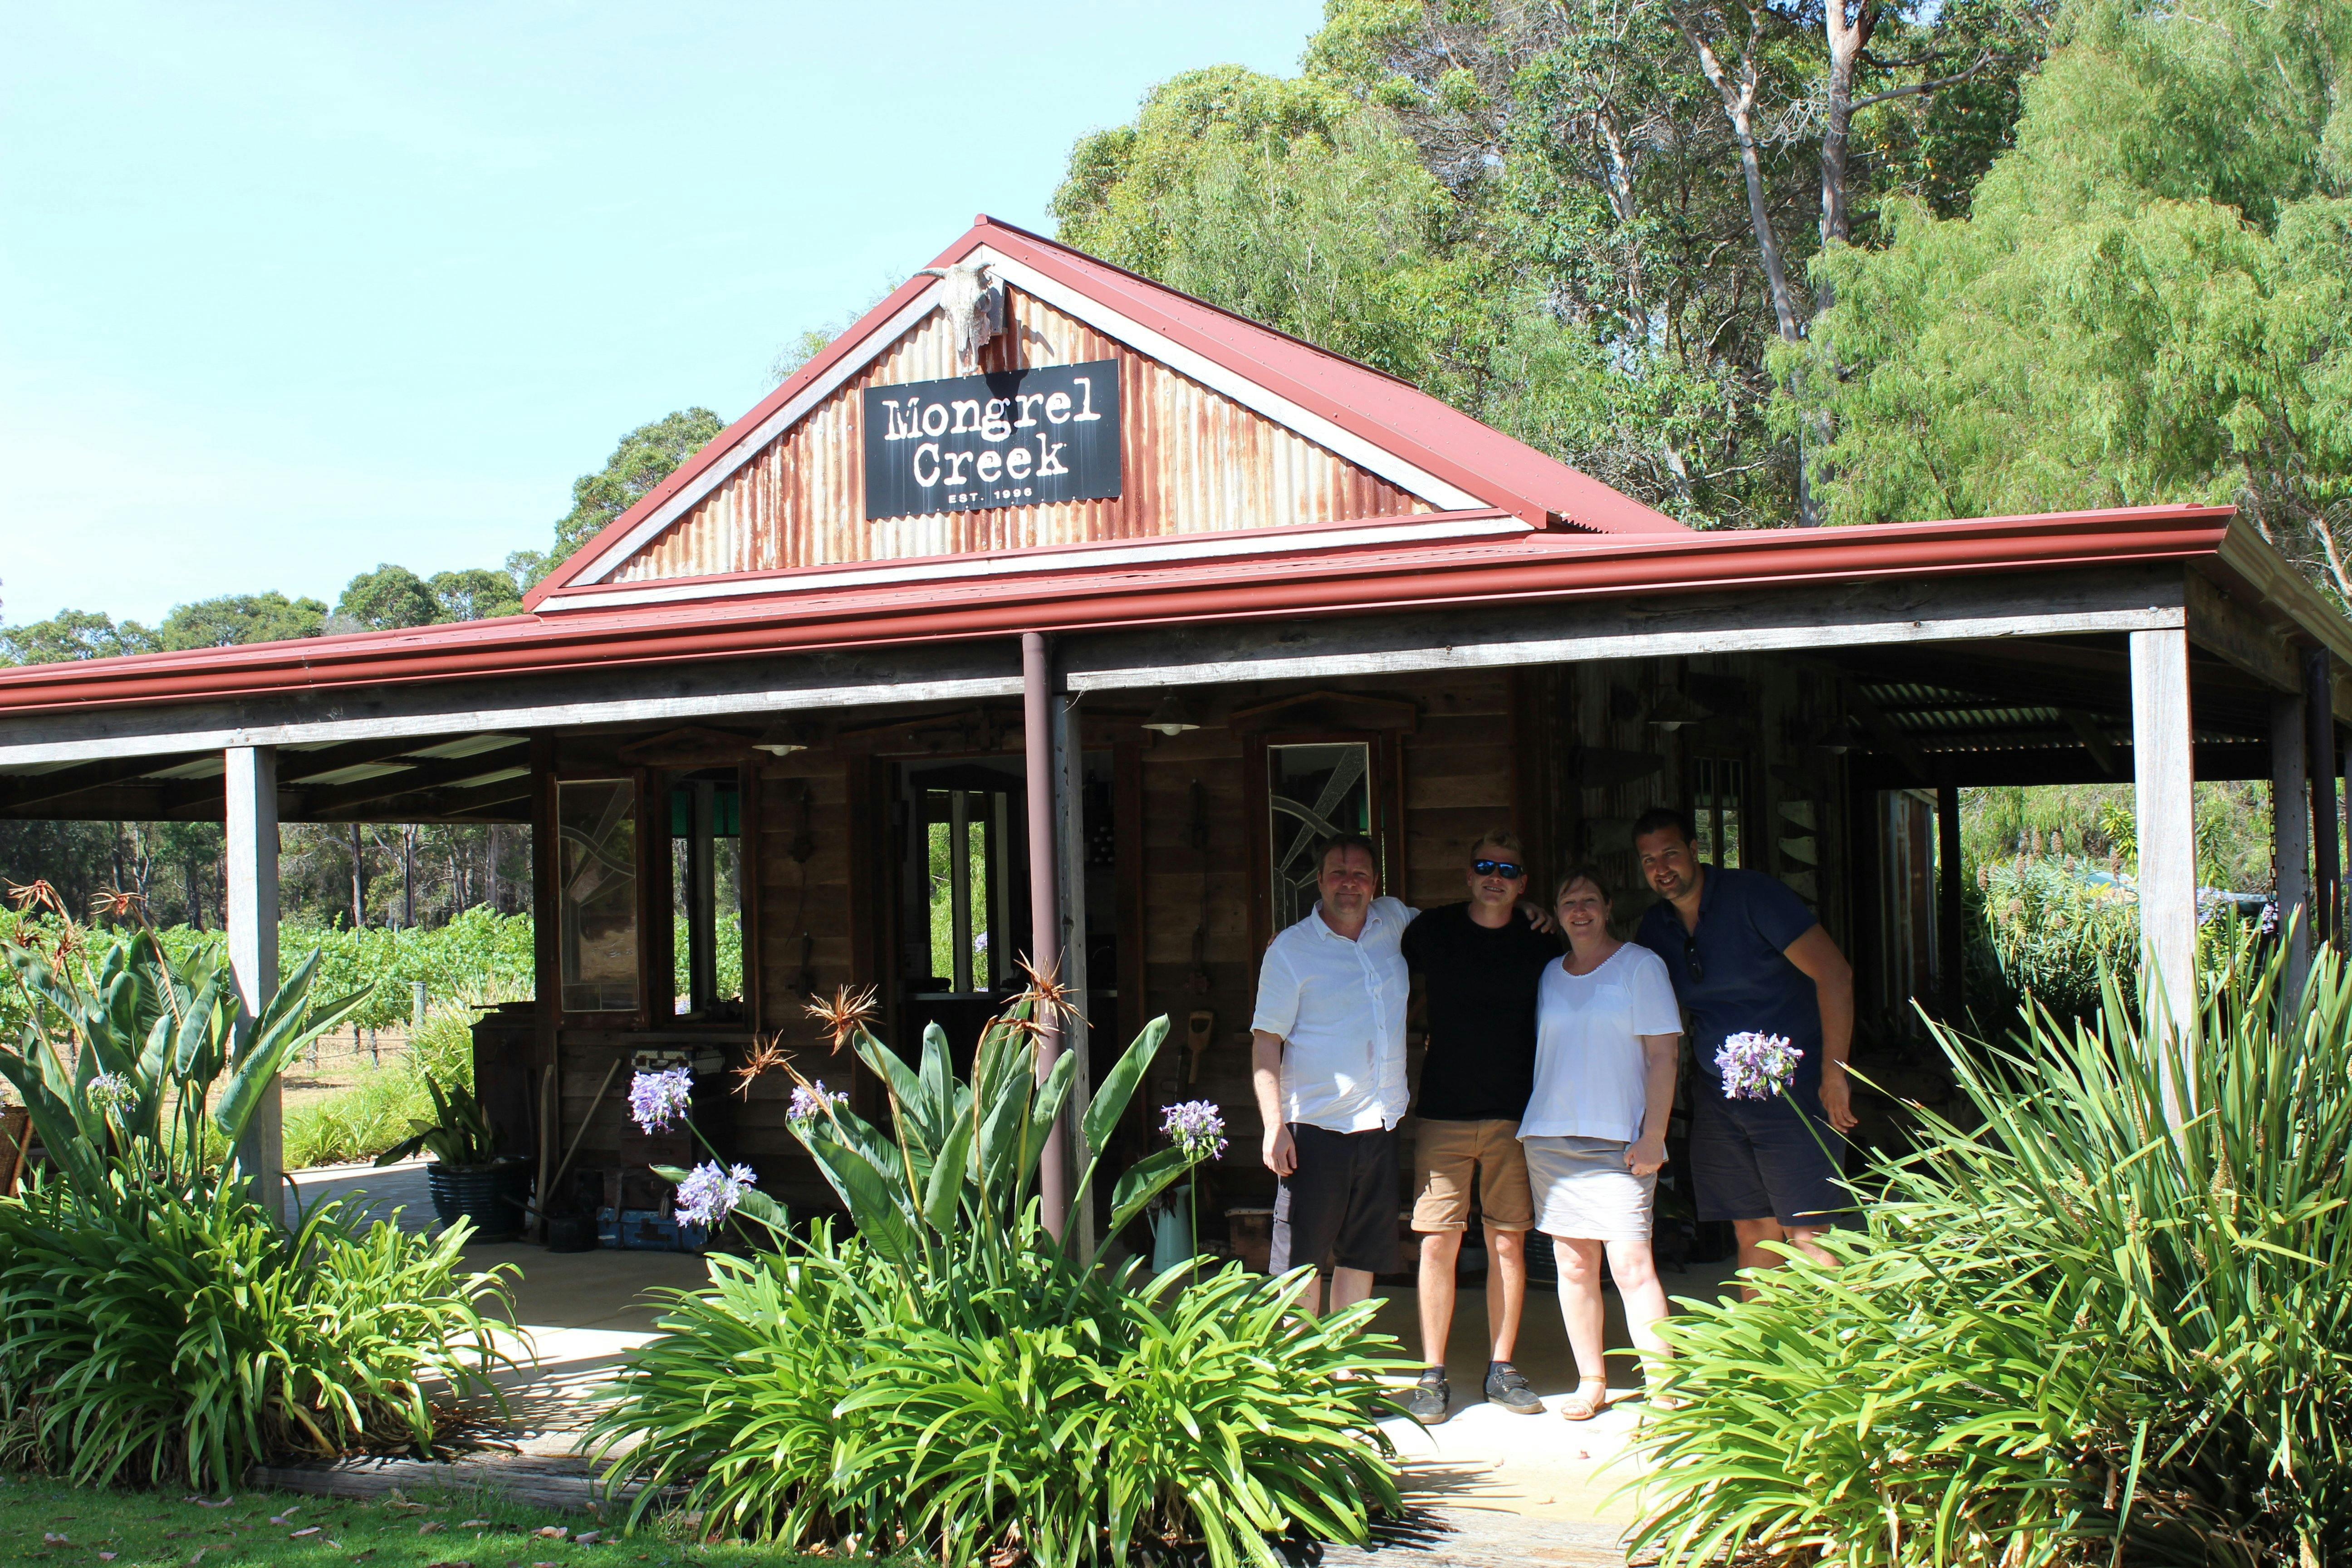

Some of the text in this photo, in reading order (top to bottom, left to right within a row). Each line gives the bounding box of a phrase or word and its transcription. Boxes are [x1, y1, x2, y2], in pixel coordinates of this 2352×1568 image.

[882, 377, 1102, 442] Mongrel
[913, 432, 1069, 488] Creek
[948, 487, 1032, 504] EST. 1996
